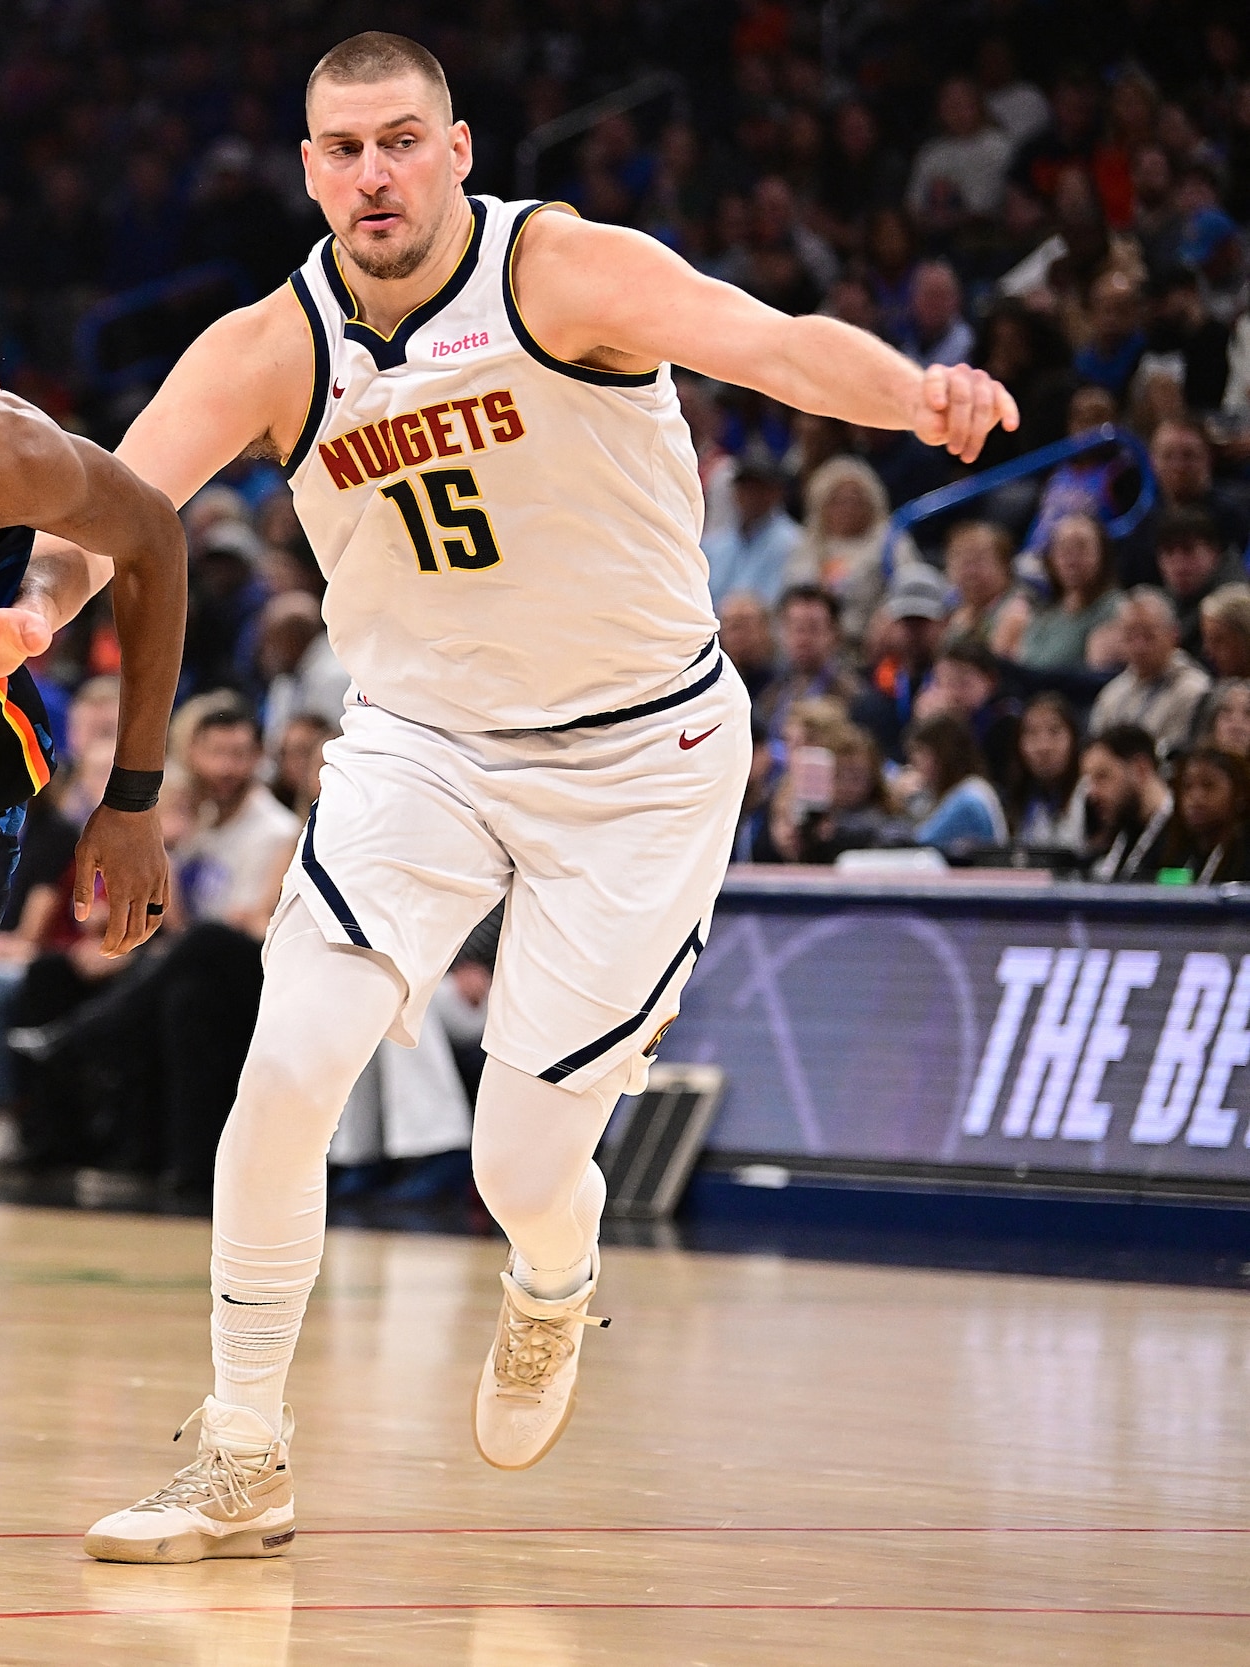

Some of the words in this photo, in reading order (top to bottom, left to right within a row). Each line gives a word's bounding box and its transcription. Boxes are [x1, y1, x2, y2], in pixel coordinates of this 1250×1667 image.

[431, 331, 489, 358] ibotta
[376, 465, 504, 575] 15
[962, 946, 1161, 1142] THE
[1129, 951, 1250, 1149] BE
